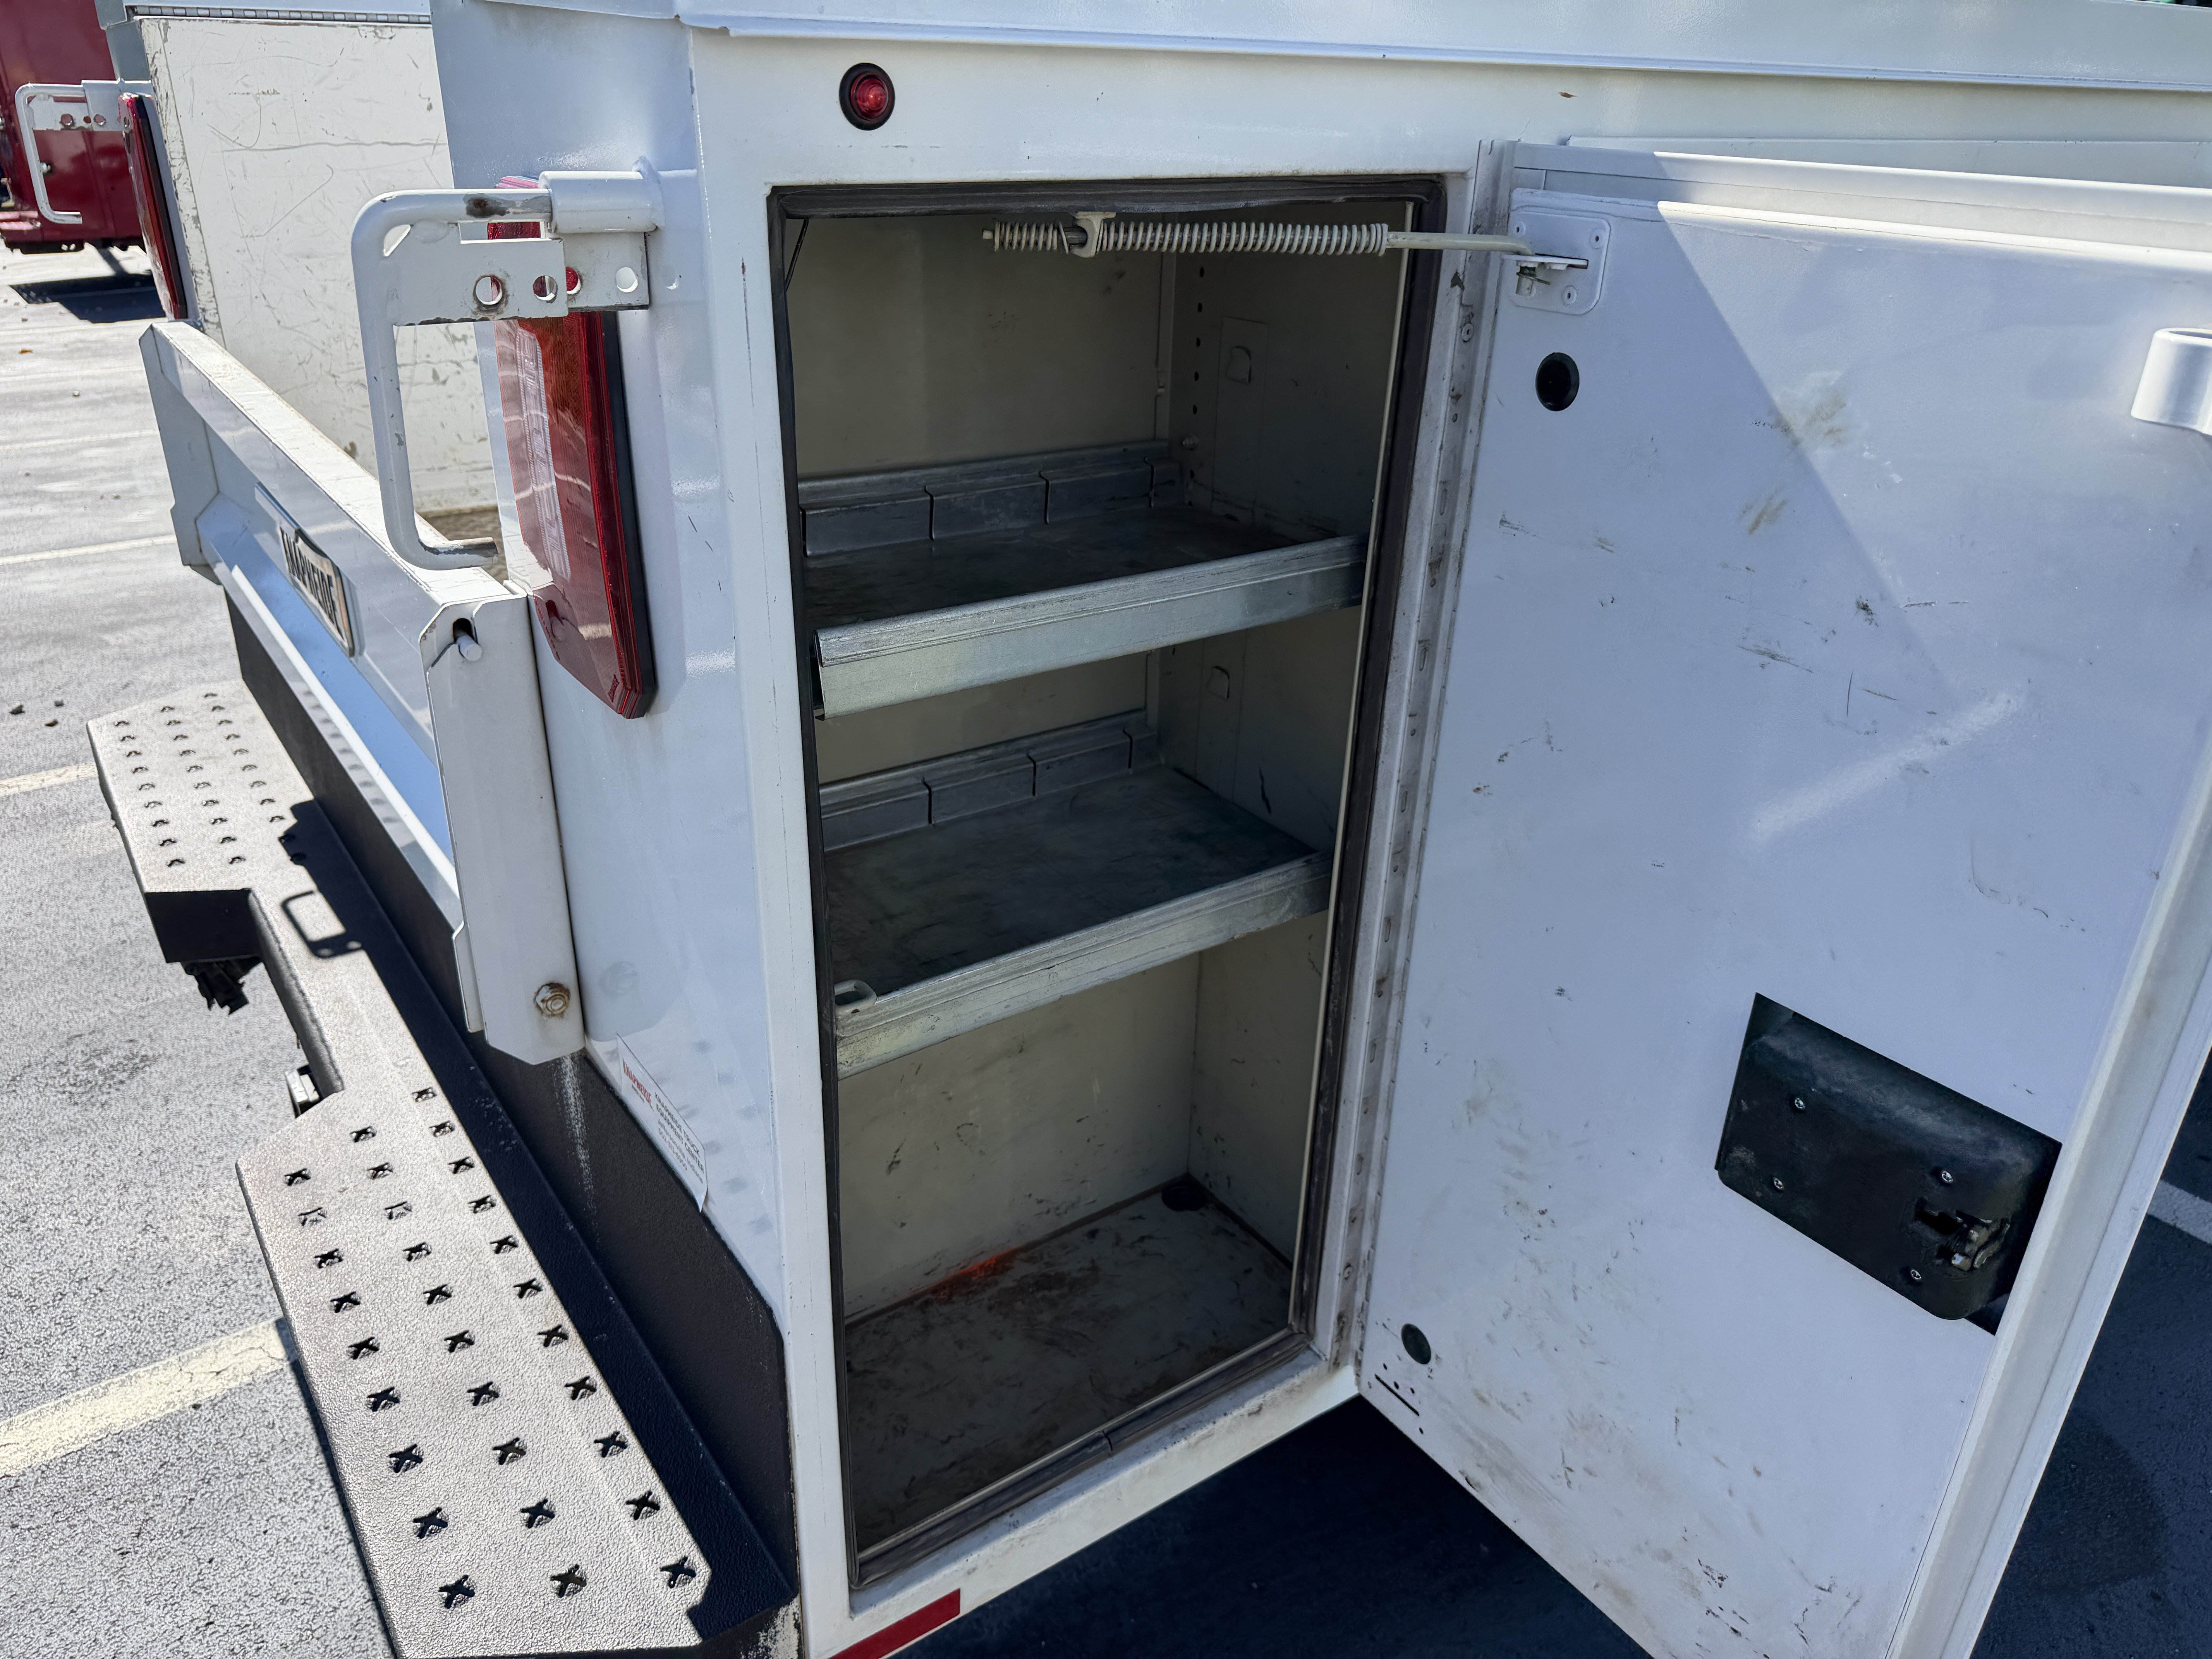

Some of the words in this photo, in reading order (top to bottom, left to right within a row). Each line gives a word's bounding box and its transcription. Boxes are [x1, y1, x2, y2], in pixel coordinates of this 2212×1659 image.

[622, 1057, 654, 1111] KNAPHEIDE
[655, 1092, 682, 1133] KNAPHEIDE
[683, 1128, 700, 1158] TRUCK
[656, 1103, 683, 1144] EQUIPMENT
[685, 1142, 704, 1173] CENTER
[1857, 1162, 1872, 1185] USA
